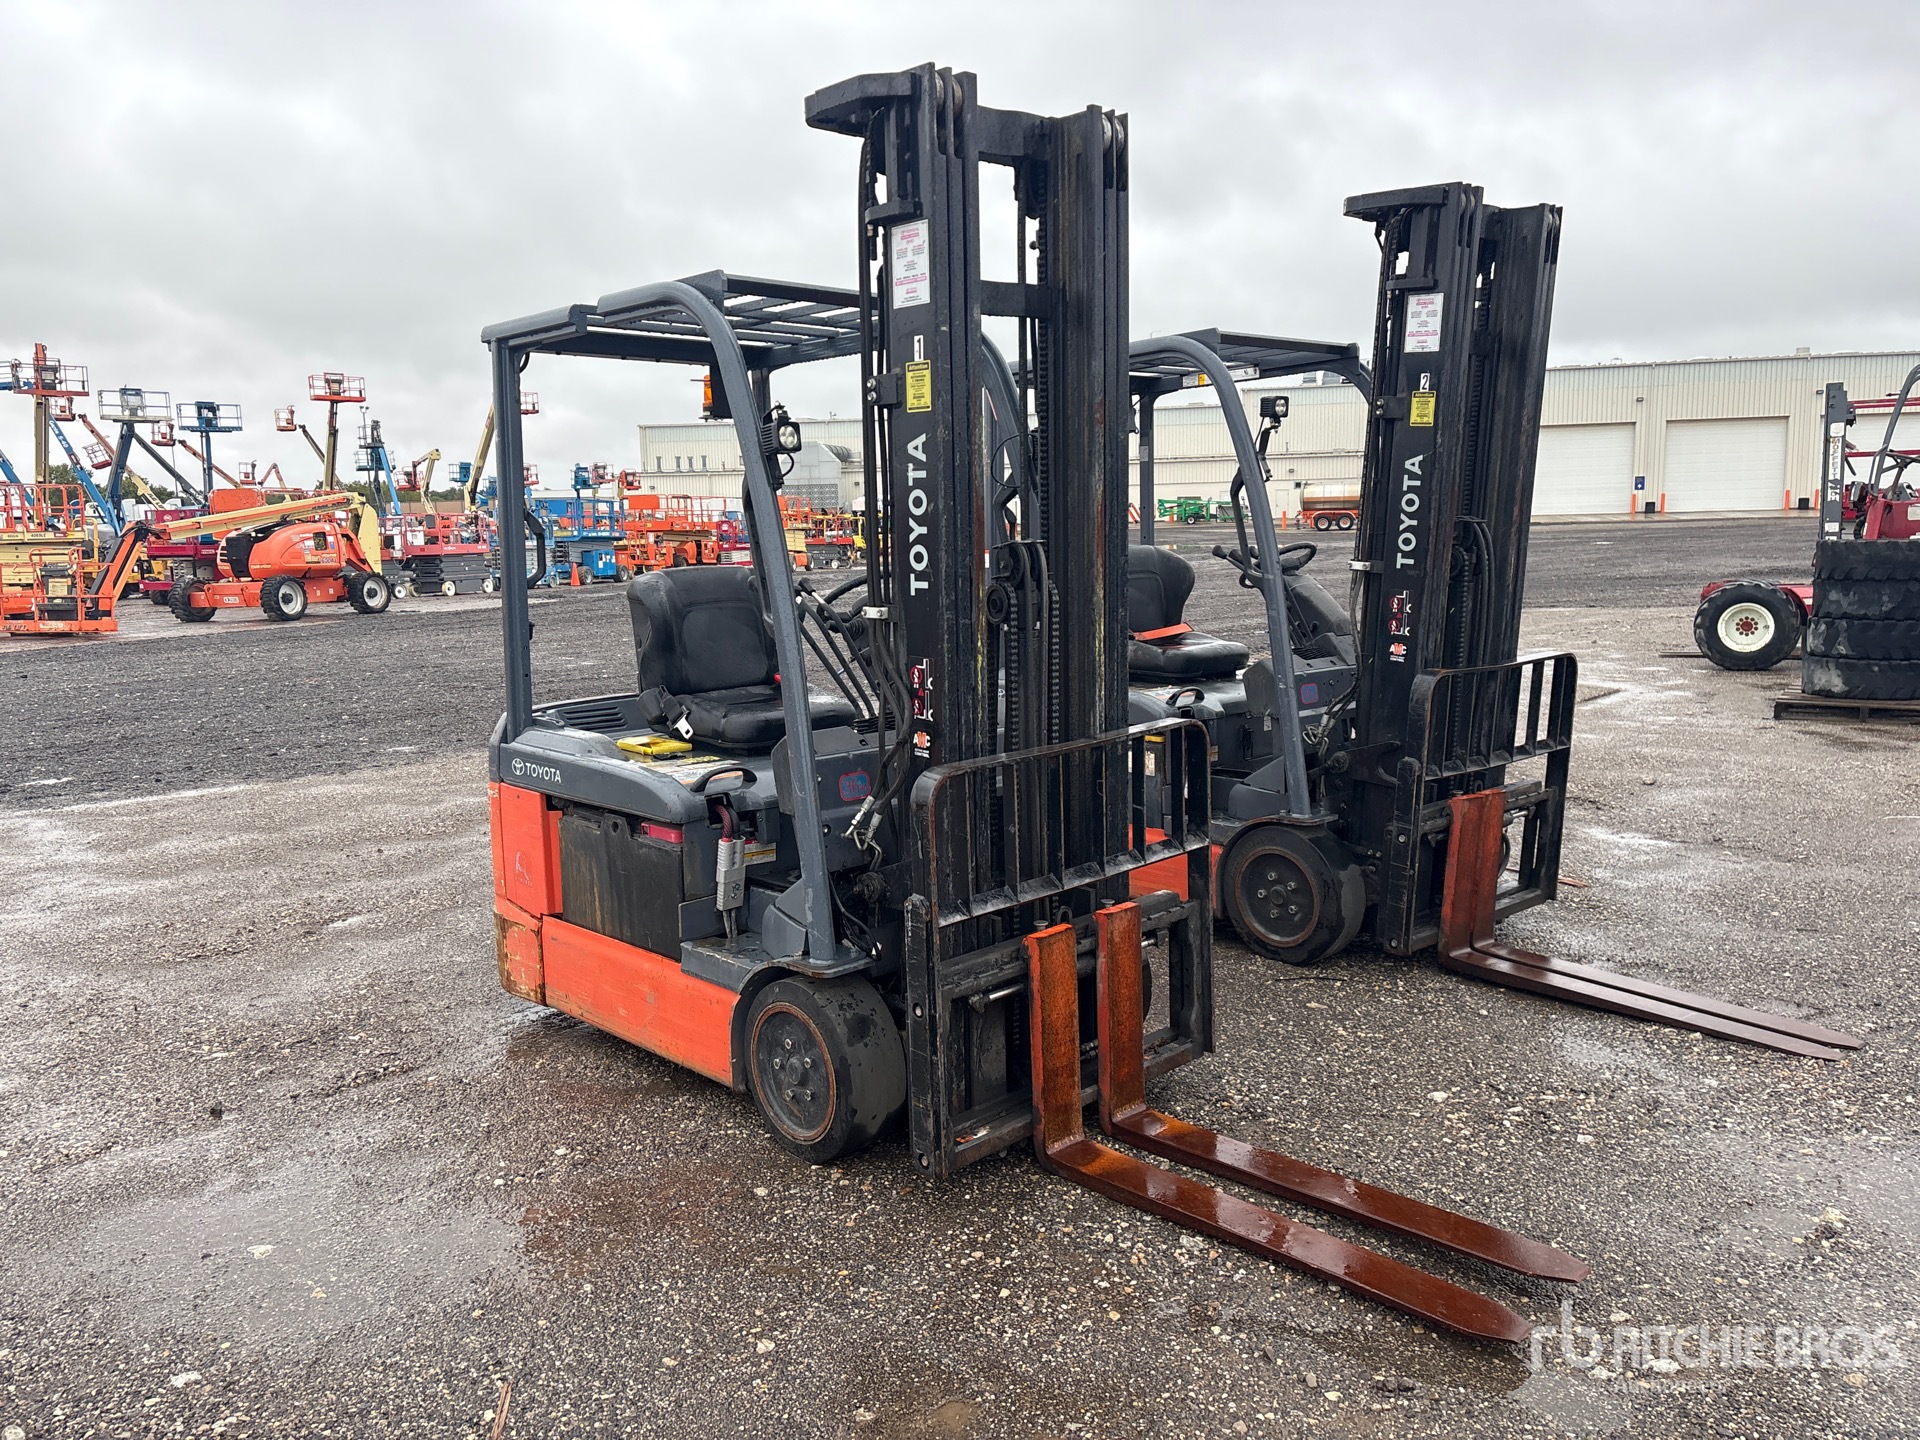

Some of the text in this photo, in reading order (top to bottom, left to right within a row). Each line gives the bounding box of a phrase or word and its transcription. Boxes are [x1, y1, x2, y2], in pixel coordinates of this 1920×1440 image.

[916, 336, 922, 360] 1
[1421, 374, 1429, 390] 2
[906, 432, 929, 597] TOYOTA
[1396, 454, 1424, 569] TOYOTA
[525, 762, 561, 784] TOYOTA
